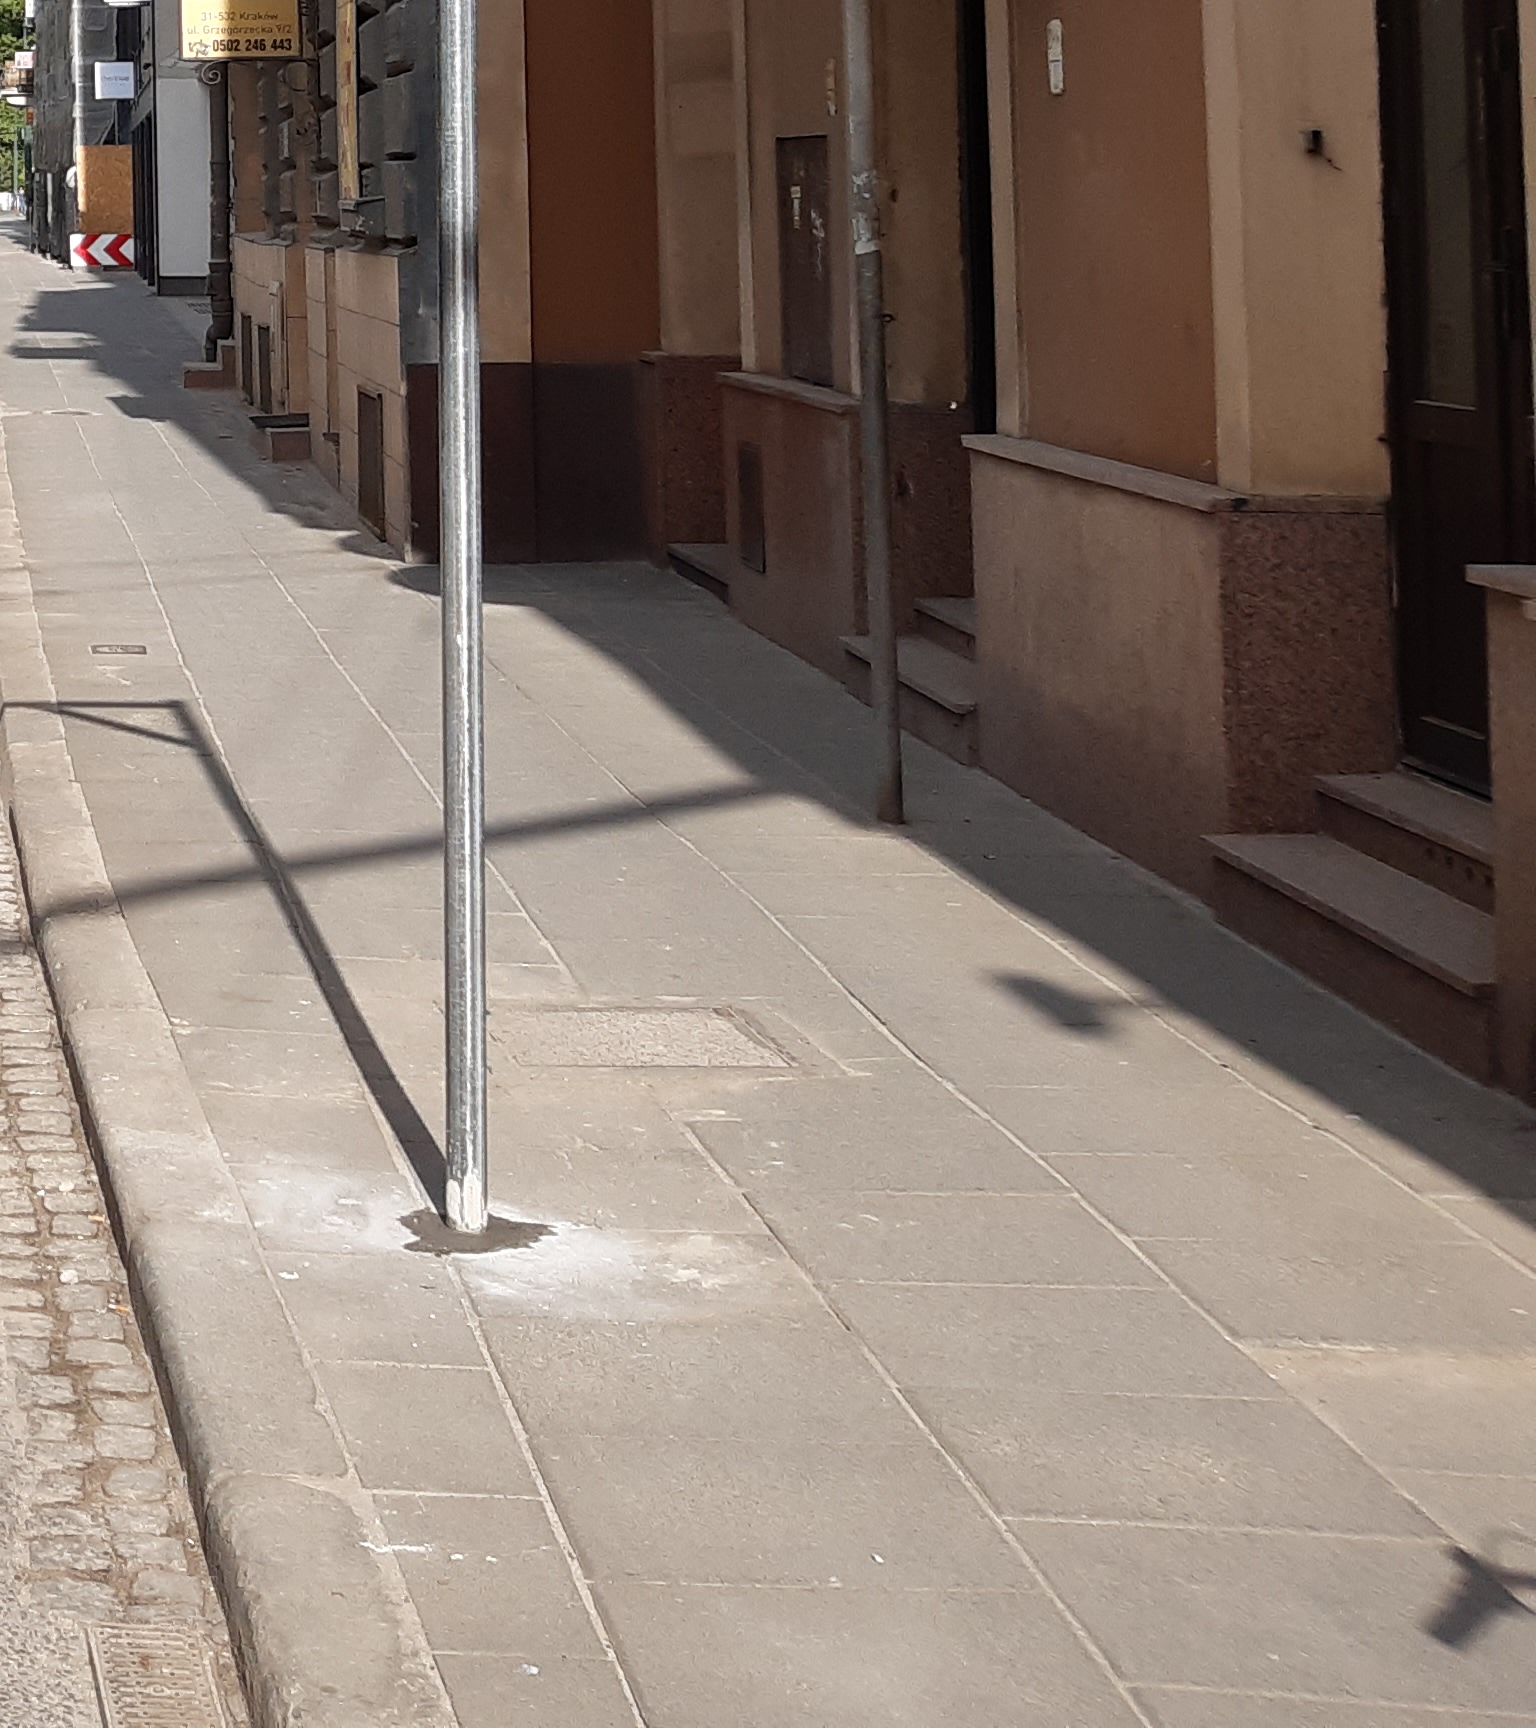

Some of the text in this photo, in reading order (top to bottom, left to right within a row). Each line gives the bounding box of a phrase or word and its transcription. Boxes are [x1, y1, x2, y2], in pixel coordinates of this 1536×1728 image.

[239, 11, 278, 21] Kraków
[187, 25, 200, 35] ul.
[212, 39, 241, 52] 0502
[244, 38, 266, 52] 246
[270, 38, 292, 51] 443
